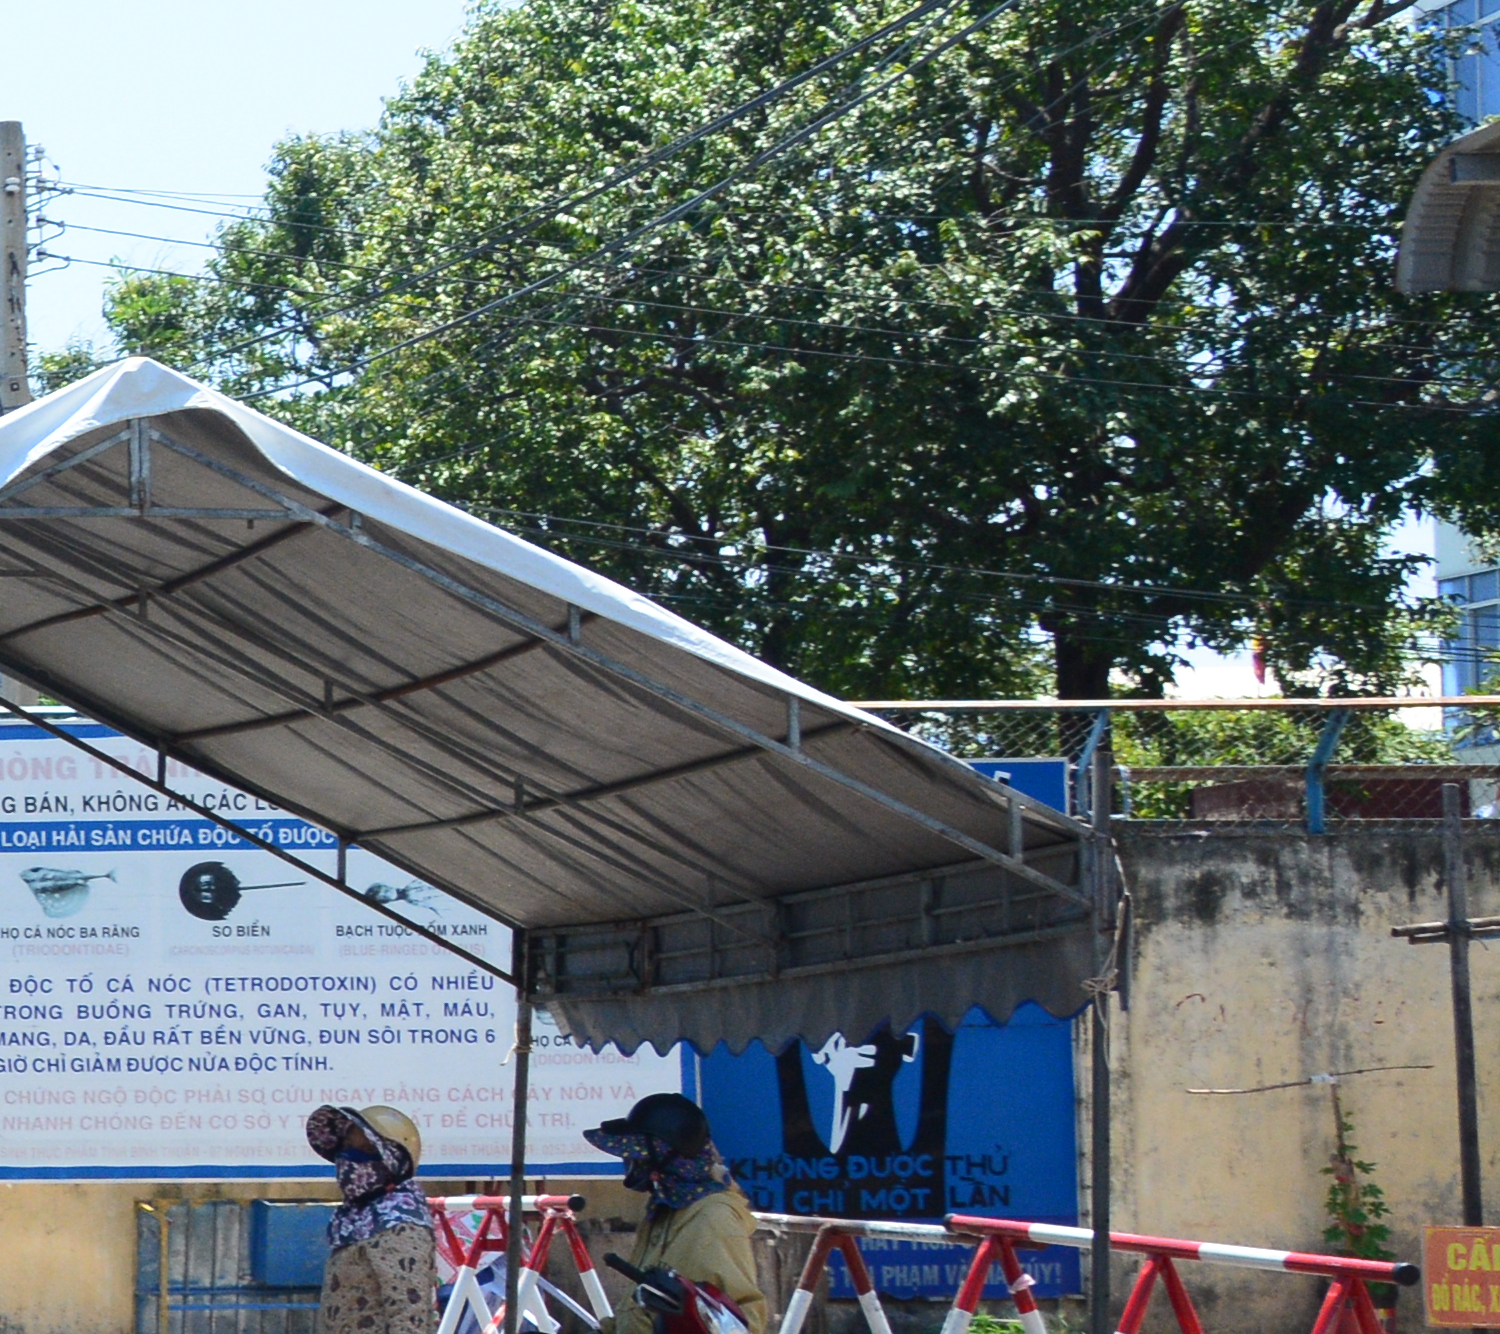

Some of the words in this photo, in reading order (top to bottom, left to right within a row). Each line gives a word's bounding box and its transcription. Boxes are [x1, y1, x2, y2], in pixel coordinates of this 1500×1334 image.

[24, 791, 75, 815] BÁN,
[82, 790, 158, 812] KHÔNG
[202, 789, 247, 811] CÁC
[1, 829, 46, 849] LOẠI
[52, 825, 84, 845] HẢI
[91, 824, 131, 845] SẢN
[138, 824, 193, 845] CHỨA
[198, 825, 241, 847] ĐỘC
[279, 826, 335, 848] ĐƯỢC
[0, 927, 20, 941] HỌ
[23, 924, 43, 939] CÁ
[46, 924, 76, 939] NÓC
[79, 926, 99, 939] BA
[212, 925, 232, 938] SO
[236, 919, 270, 937] BIỂN
[336, 925, 373, 940] BẠCH
[378, 923, 415, 939] TUỘC
[451, 924, 488, 937] XANH
[9, 975, 53, 996] ĐỘC
[66, 972, 94, 993] TỐ
[106, 974, 134, 993] CÁ
[148, 974, 191, 993] NÓC
[204, 975, 376, 995] (TETRODOTOXIN)
[389, 972, 418, 991] CÓ
[432, 969, 494, 991] NHIỀU
[77, 998, 152, 1020] BUỒNG
[165, 1000, 244, 1021] TRỨNG,
[257, 1003, 307, 1021] GAN,
[320, 1003, 367, 1021] TỤY,
[381, 999, 430, 1021] MẬT,
[443, 998, 495, 1019] MÁU,
[64, 1031, 97, 1048] DA,
[103, 1024, 145, 1046] ĐẦU
[153, 1024, 194, 1045] RẤT
[200, 1024, 242, 1045] BỀN
[249, 1026, 312, 1047] VỮNG,
[319, 1029, 360, 1045] ĐUN
[368, 1026, 401, 1044] SÔI
[408, 1028, 478, 1044] TRONG
[485, 1028, 496, 1044] 6
[32, 1053, 67, 1073] CHỈ
[71, 1052, 121, 1073] GIẢM
[126, 1057, 184, 1075] ĐƯỢC
[188, 1051, 230, 1072] NỬA
[235, 1053, 277, 1075] ĐỘC
[282, 1053, 334, 1071] TÍNH.
[4, 1087, 76, 1105] CHỨNG
[84, 1087, 127, 1106] NGỘ
[134, 1087, 176, 1106] ĐỘC
[185, 1085, 230, 1103] PHẢI
[272, 1084, 313, 1103] CỨU
[321, 1087, 375, 1103] NGAY
[383, 1082, 441, 1102] BẰNG
[447, 1083, 503, 1102] CÁCH
[560, 1083, 605, 1101] NÔN
[610, 1082, 636, 1100] VÀ
[2, 1117, 72, 1131] NHANH
[80, 1113, 152, 1131] CHÓNG
[161, 1110, 201, 1130] ĐẾN
[278, 1115, 291, 1129] Y
[441, 1109, 467, 1128] ĐỂ
[729, 1153, 842, 1181] KHÔNG
[847, 1153, 935, 1181] ĐƯỢC
[861, 1181, 931, 1213] MỘT
[883, 1265, 939, 1291] PHẠM
